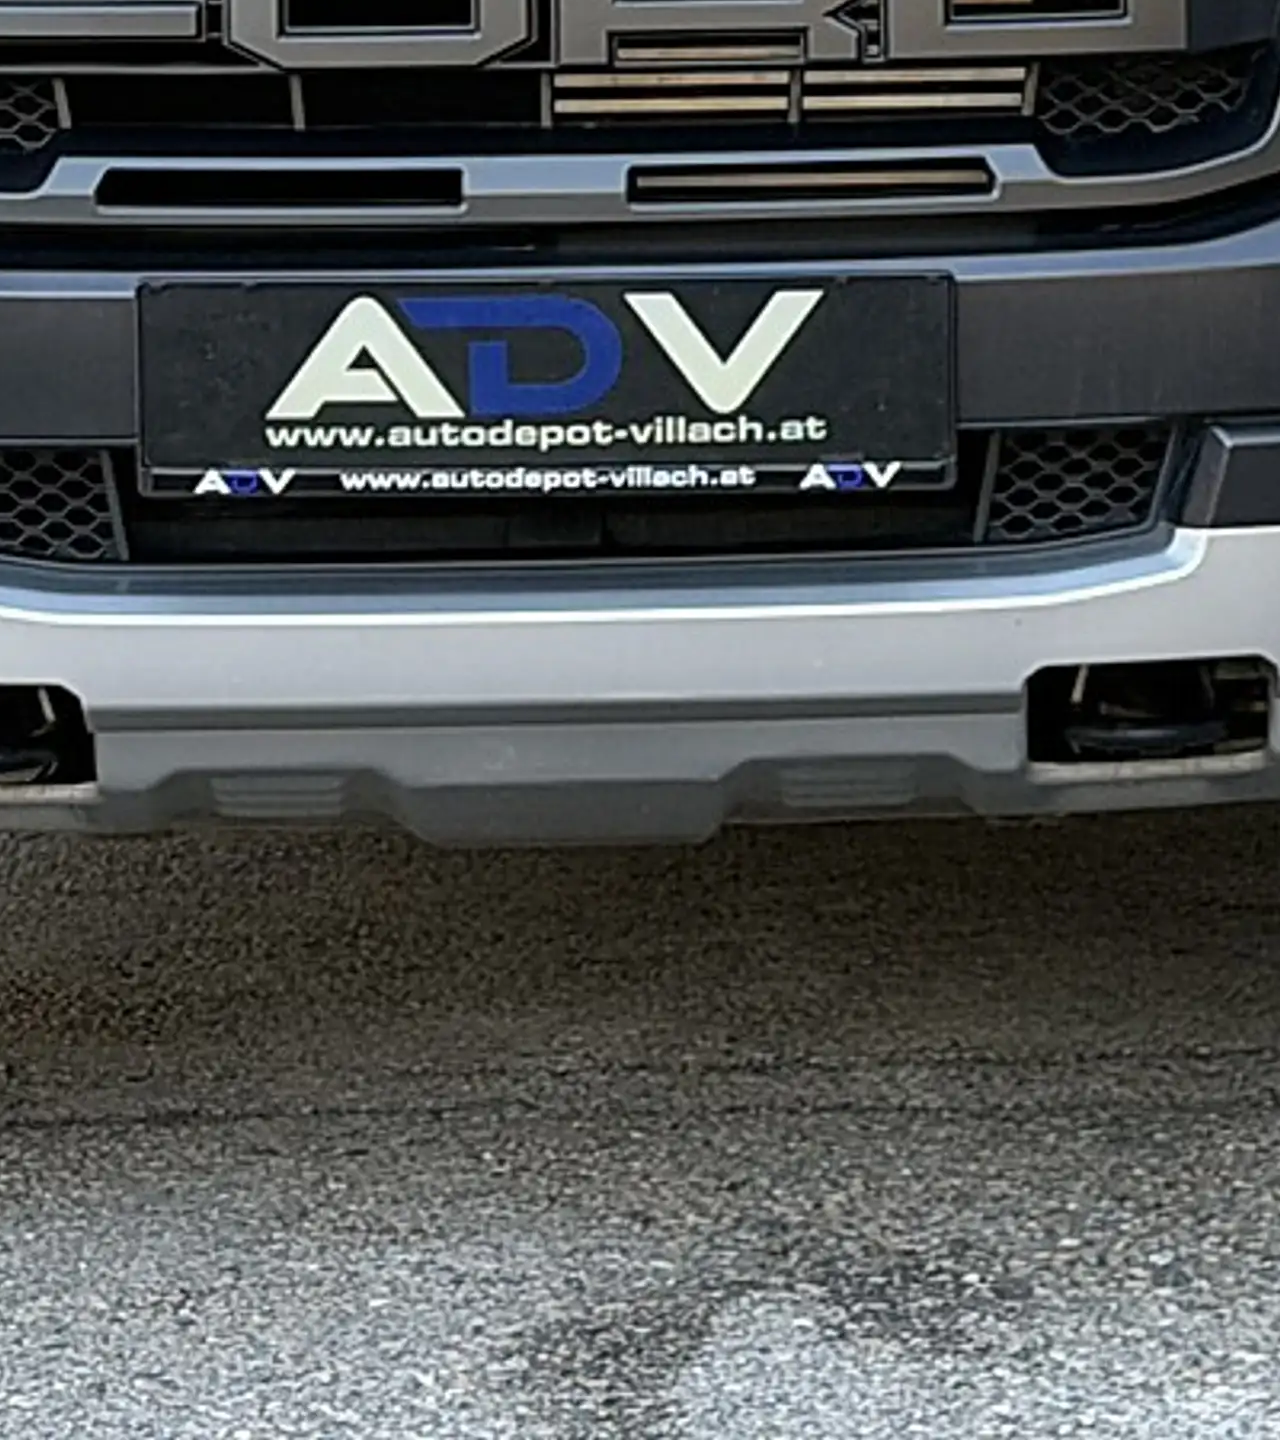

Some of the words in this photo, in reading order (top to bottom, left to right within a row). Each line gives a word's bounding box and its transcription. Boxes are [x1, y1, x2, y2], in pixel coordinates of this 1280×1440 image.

[266, 290, 825, 419] ADV
[266, 415, 827, 451] www.autodepot-villach.at
[339, 464, 756, 493] www.autodepot-villach.at
